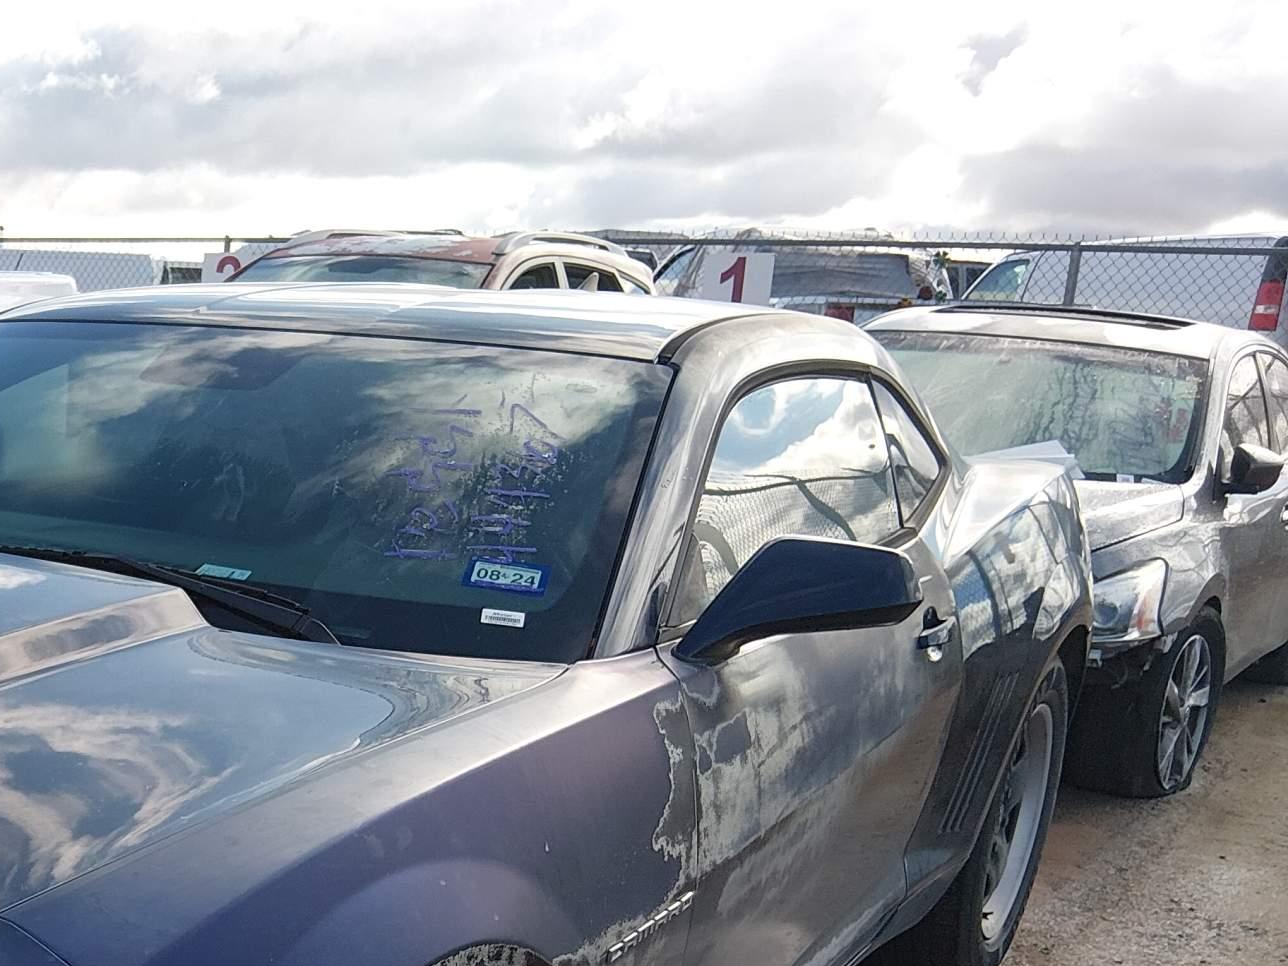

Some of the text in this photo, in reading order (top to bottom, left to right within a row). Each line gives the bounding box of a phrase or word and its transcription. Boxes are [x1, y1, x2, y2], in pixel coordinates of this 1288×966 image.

[719, 256, 747, 303] 1
[476, 568, 536, 586] 08 24
